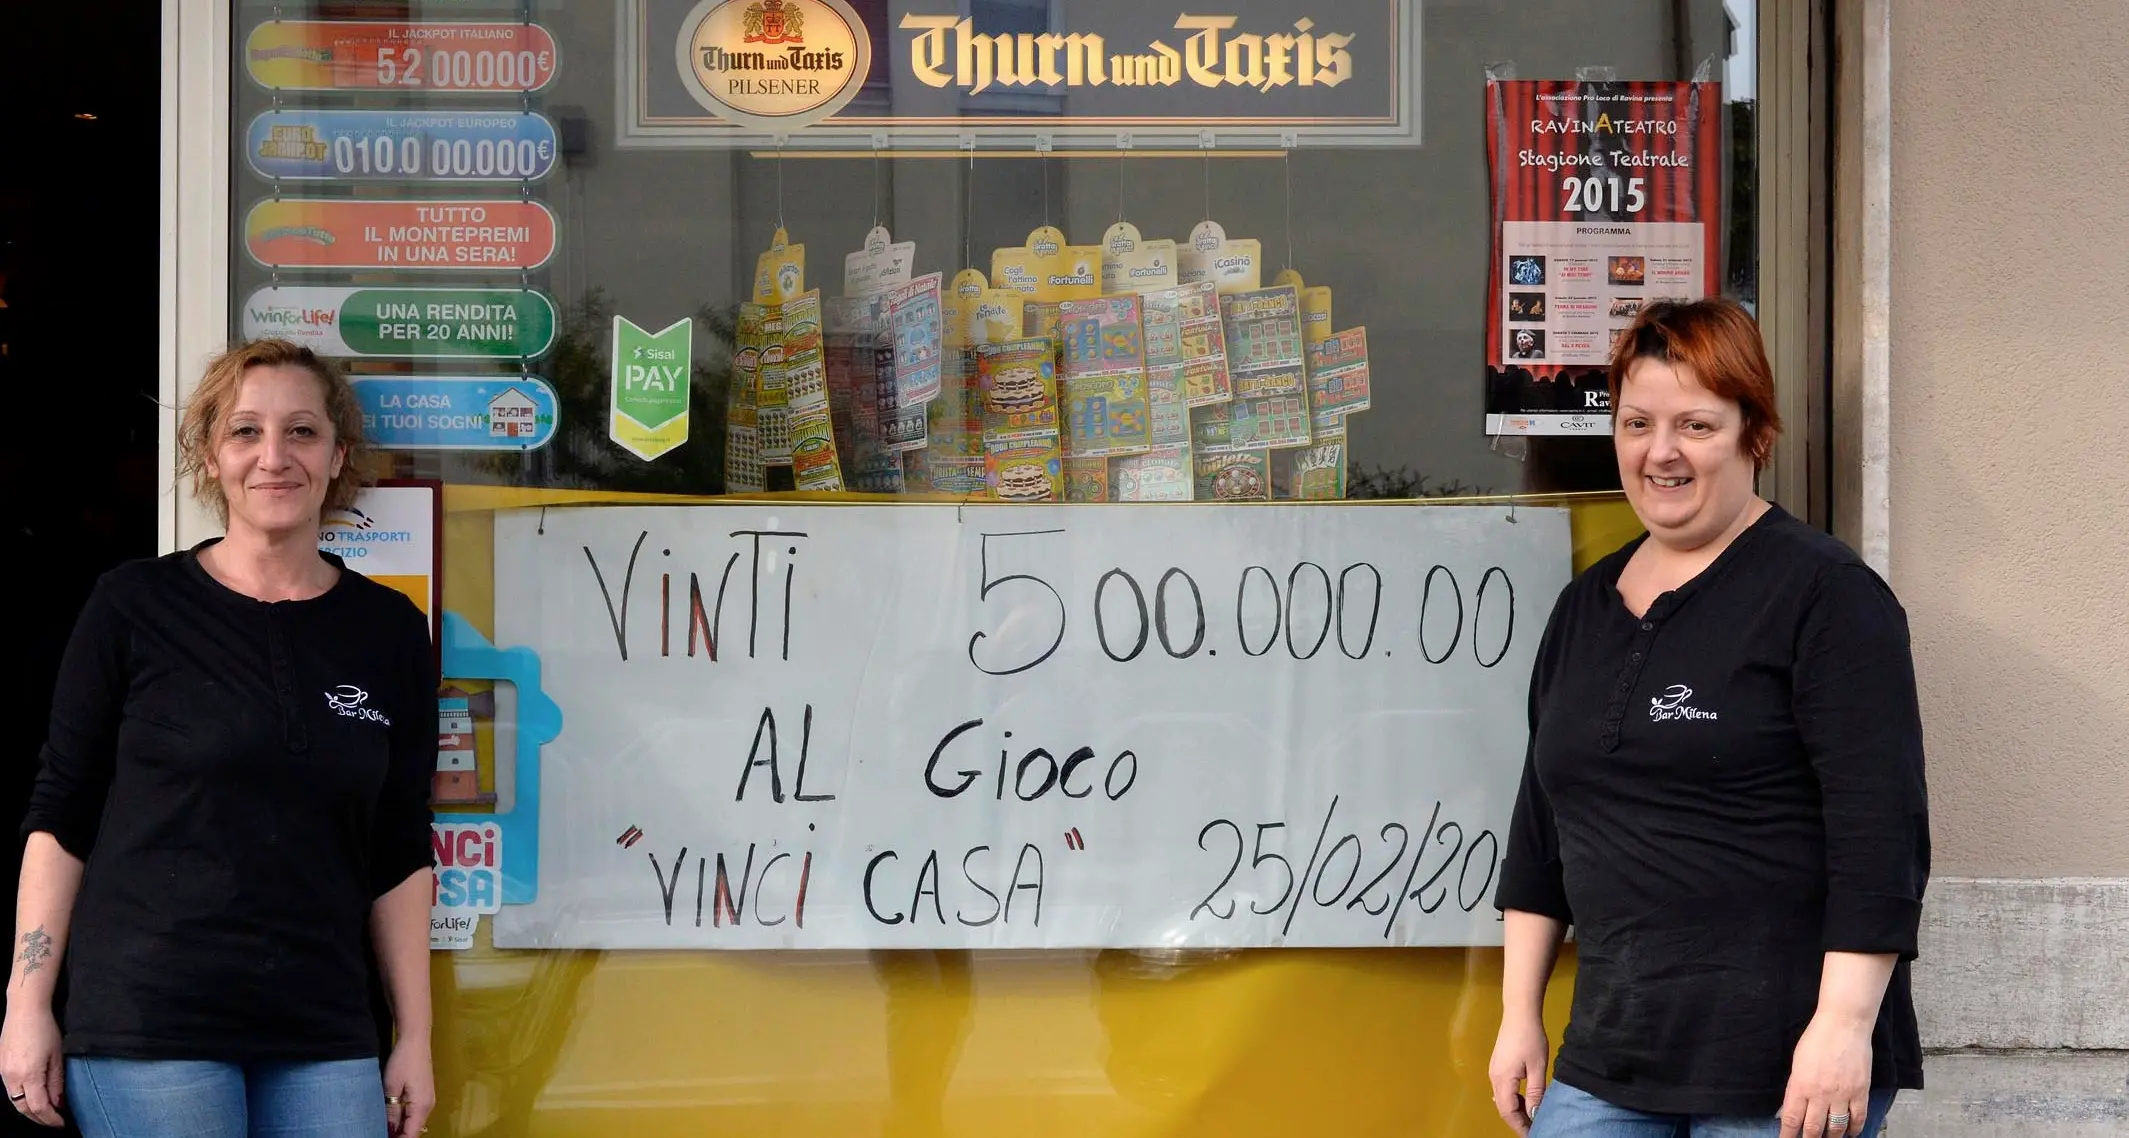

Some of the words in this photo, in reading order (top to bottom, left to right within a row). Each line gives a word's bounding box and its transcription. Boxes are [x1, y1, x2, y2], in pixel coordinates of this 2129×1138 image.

[388, 29, 399, 39] IL
[401, 29, 455, 40] JACKPOT
[460, 29, 514, 40] ITALIANO
[700, 46, 766, 72] Thurn
[766, 55, 789, 70] und
[787, 46, 844, 73] Taxis
[899, 12, 1109, 96] Thurn
[1109, 40, 1182, 87] und
[1173, 12, 1357, 94] Taxis
[728, 78, 821, 95] PILSENER
[386, 118, 397, 128] IL
[399, 118, 454, 129] JACKPOT
[457, 118, 517, 129] EUROPEO
[1518, 149, 1603, 172] Stagione
[1610, 150, 1689, 167] Teatrale
[1562, 177, 1646, 213] 2015
[416, 207, 486, 223] TUTTO
[364, 227, 382, 242] IL
[389, 226, 530, 243] MONTEPREMI
[1576, 227, 1631, 235] PROGRAMMA
[378, 246, 398, 261] IN
[405, 246, 450, 262] UNA
[455, 246, 516, 262] SERA!
[376, 304, 420, 320] UNA
[427, 304, 517, 320] RENDITA
[378, 324, 420, 340] PER
[427, 324, 450, 340] 20
[456, 324, 513, 340] ANNI!
[647, 348, 675, 360] Sisal
[625, 365, 683, 392] PAY
[380, 394, 400, 409] LA
[406, 394, 452, 409] CASA
[1584, 391, 1612, 408] Rav
[363, 414, 375, 430] EI
[380, 415, 424, 430] TUOI
[429, 415, 483, 430] SOGNI
[338, 530, 411, 542] TRASPORTI
[337, 705, 357, 718] Bar
[1652, 707, 1675, 722] Bar
[1674, 705, 1718, 721] Milena
[735, 704, 836, 804] AL
[1189, 795, 1504, 938] 25/02/20
[432, 868, 494, 908] SA
